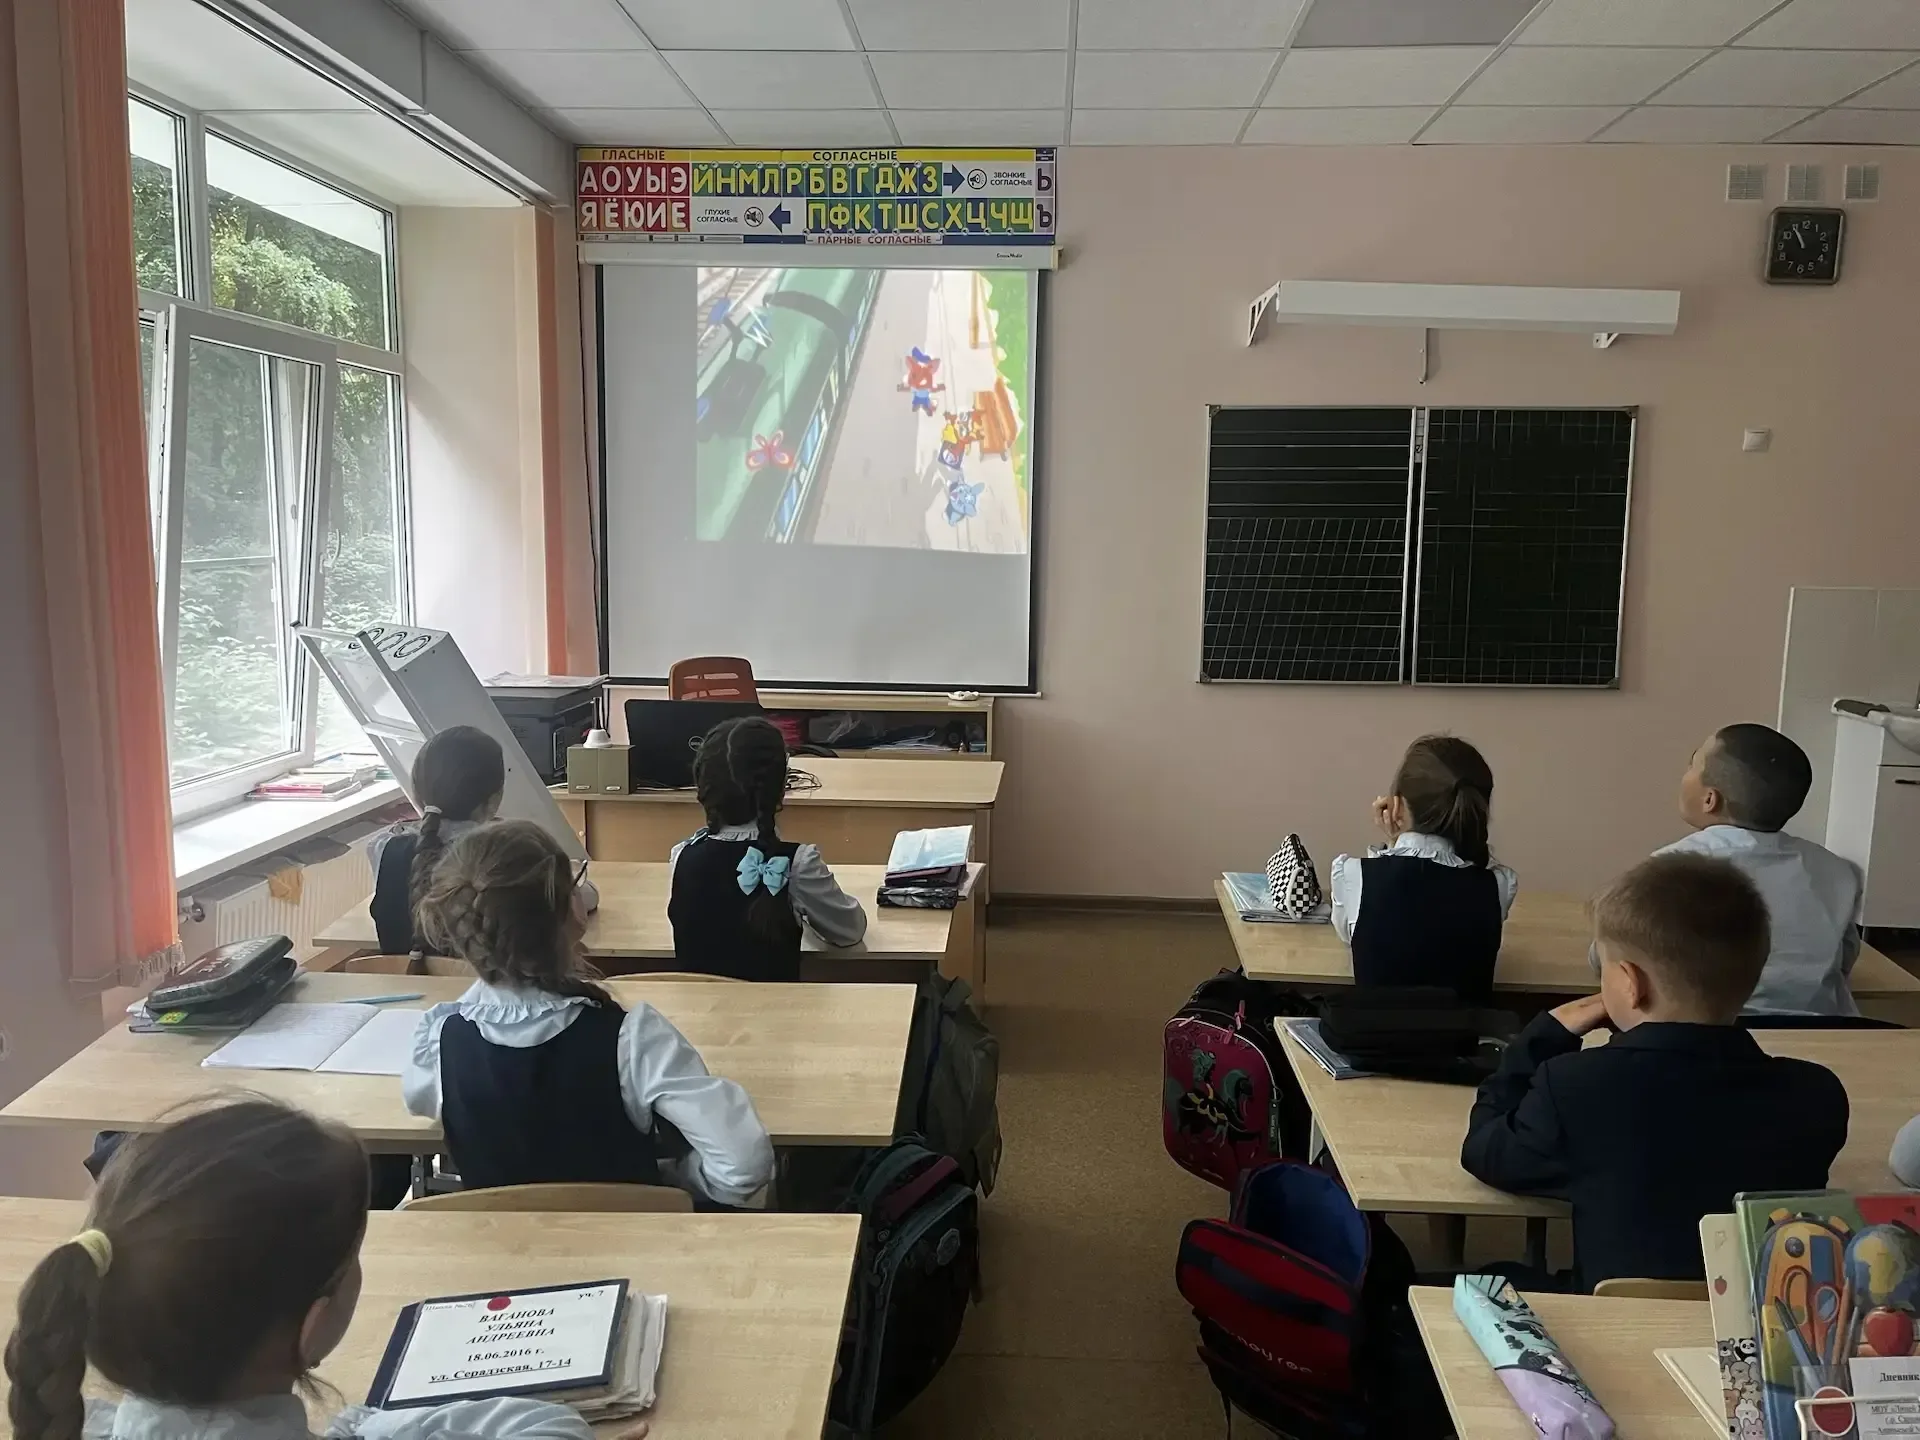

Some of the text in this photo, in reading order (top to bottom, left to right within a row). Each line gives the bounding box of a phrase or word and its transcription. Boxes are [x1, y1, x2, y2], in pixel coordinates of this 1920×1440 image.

[602, 150, 665, 161] ГЛАСНЫЕ
[812, 151, 897, 161] СОГЛАСНЫЕ
[705, 208, 730, 216] ГЛУХИЕ
[1802, 220, 1811, 229] 12
[818, 236, 931, 244] ПАРНЫЕ СОГЛАСНЫЕ
[1783, 231, 1792, 240] 10
[1820, 232, 1827, 241] 2
[1778, 243, 1784, 251] 9
[1822, 243, 1829, 252] 3
[1779, 252, 1786, 260] 8
[1817, 254, 1824, 262] 4
[1788, 261, 1794, 270] 7
[1797, 264, 1804, 274] 6
[1808, 262, 1814, 271] 5
[478, 1308, 555, 1324] ВАГАНОВА
[484, 1319, 544, 1333] УЛЬЯНА
[465, 1328, 555, 1345] АНДРЕЕВНА
[467, 1347, 531, 1362] 18.06.2016
[430, 1373, 449, 1382] ул.
[537, 1358, 572, 1370] 17-14
